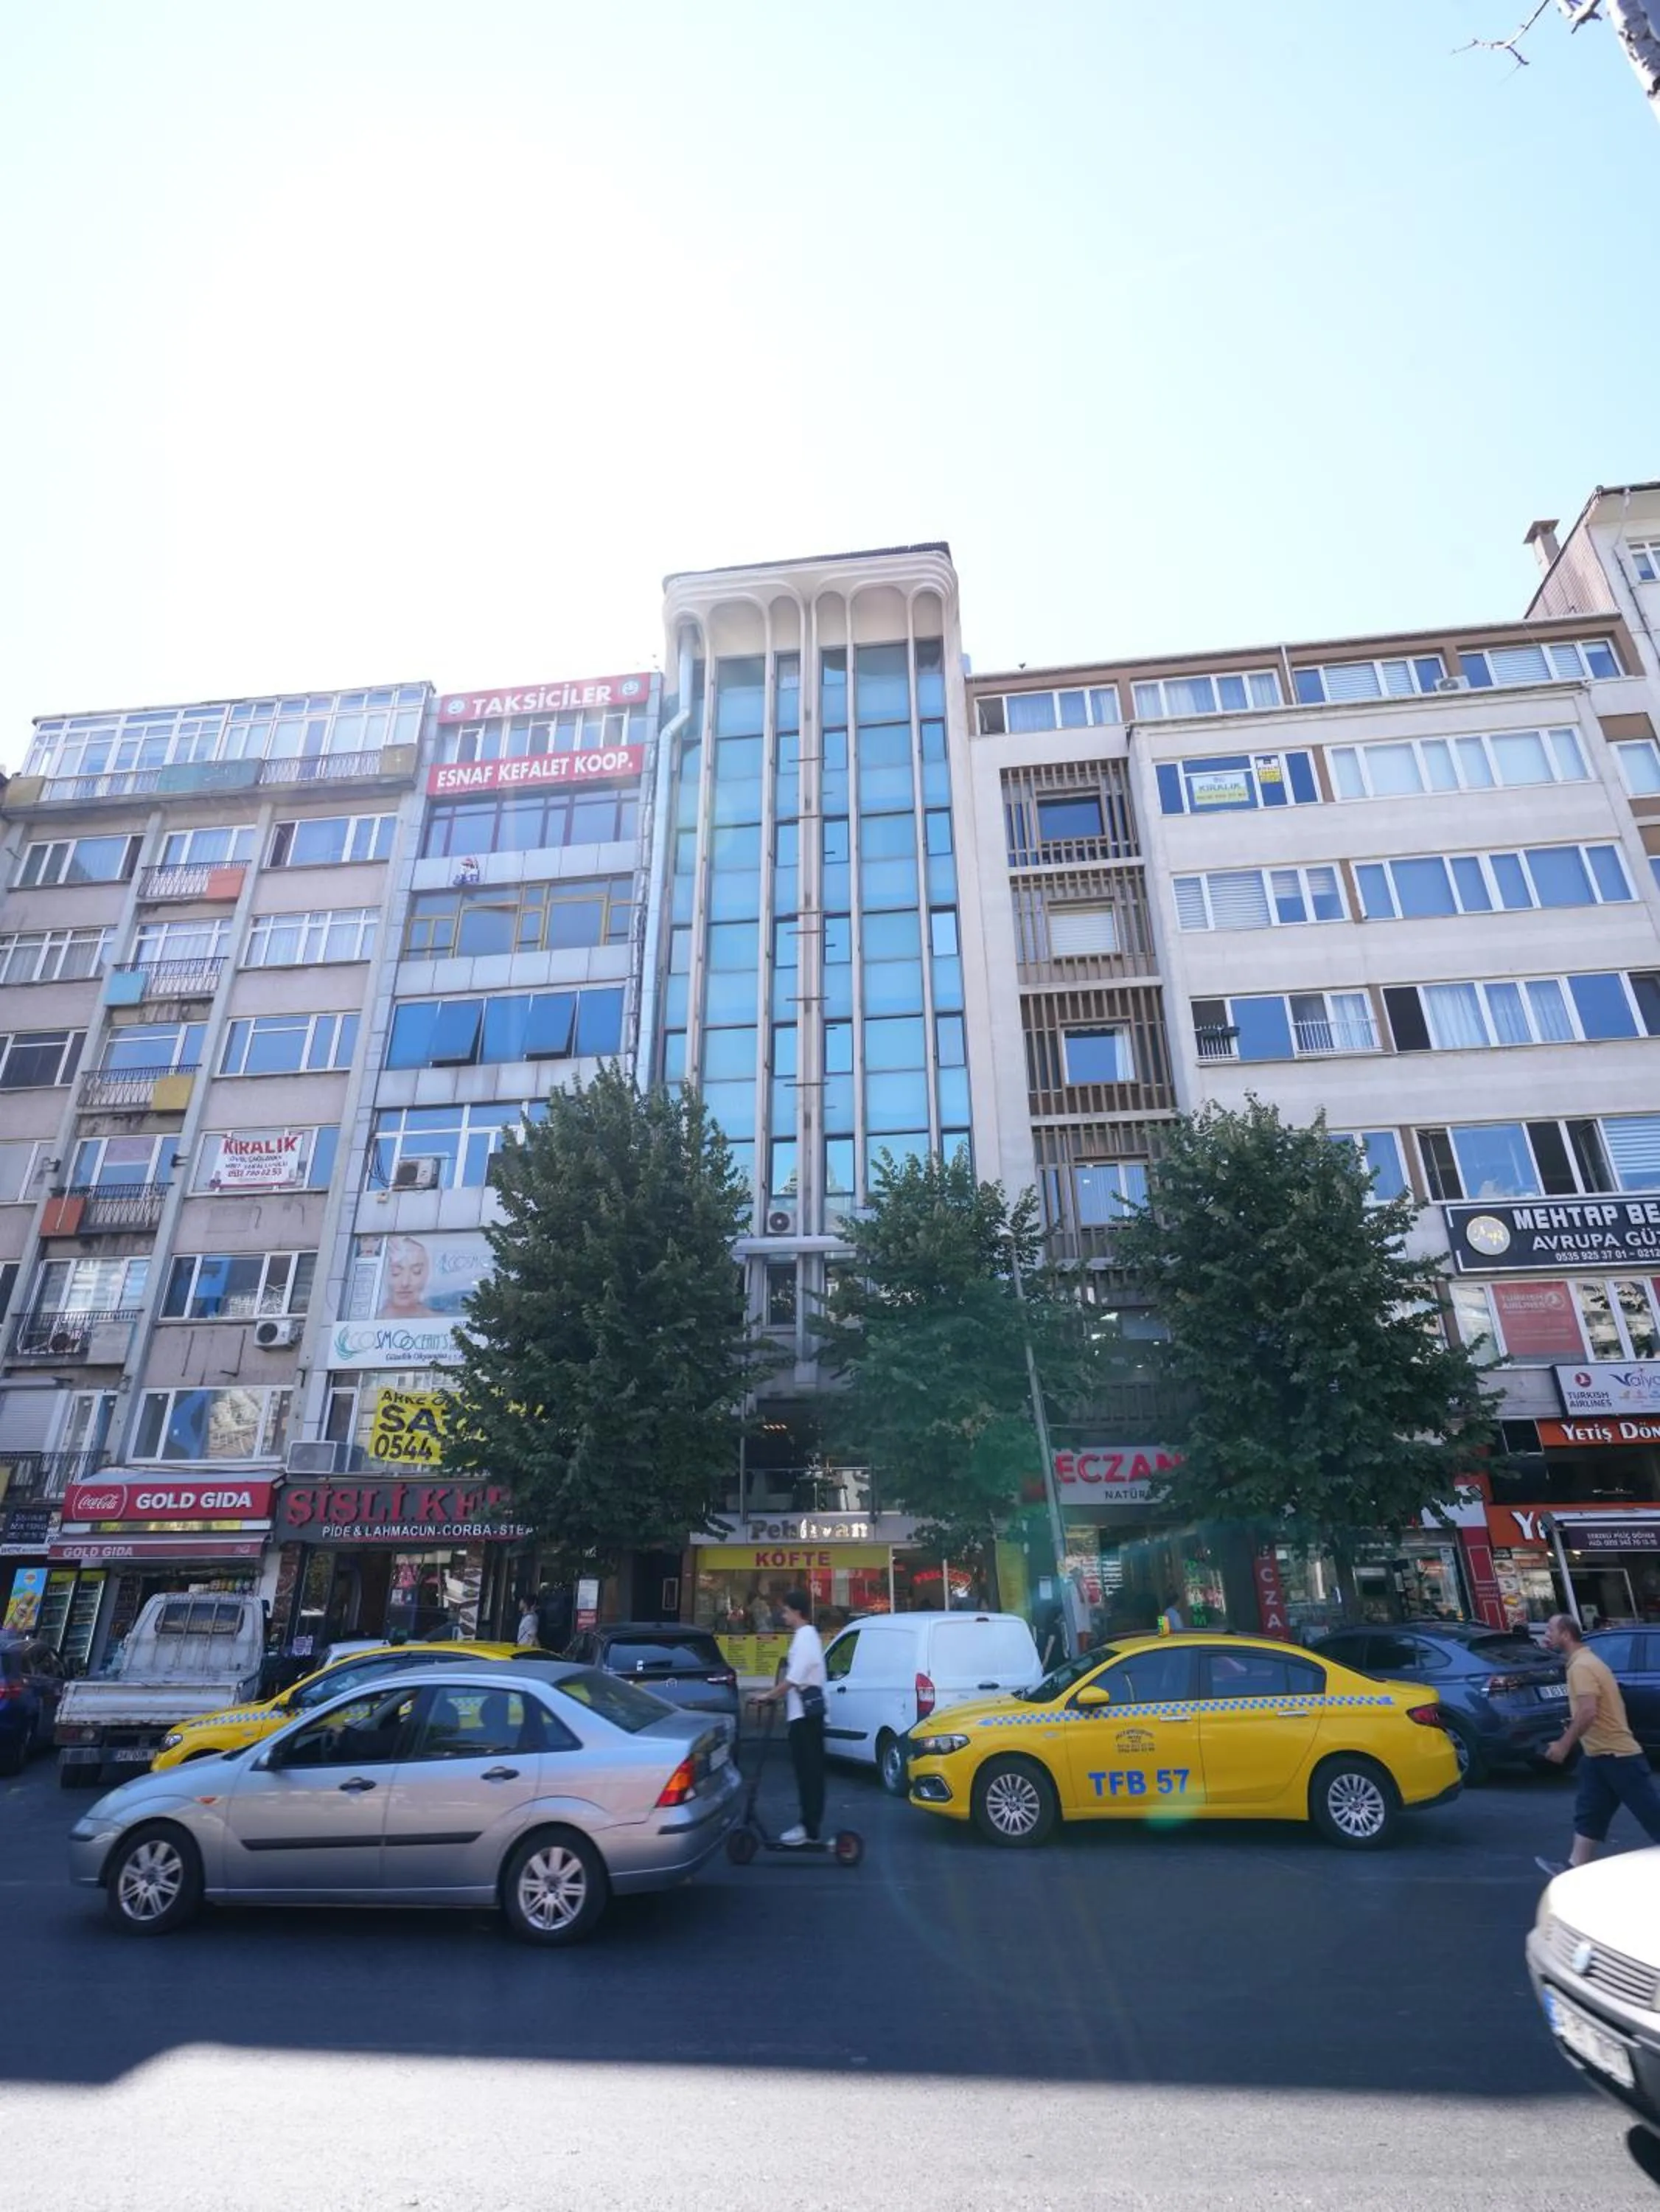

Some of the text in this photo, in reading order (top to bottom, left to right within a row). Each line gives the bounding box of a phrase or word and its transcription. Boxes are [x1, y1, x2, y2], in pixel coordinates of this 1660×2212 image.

[472, 684, 612, 715] TAKSİCİLER
[436, 751, 634, 787] ESNAF KEFALET KOOP.
[1513, 1205, 1619, 1230] MEHTAP
[1532, 1232, 1621, 1251] AVRUPA
[1555, 1251, 1580, 1262] 0535
[1600, 1250, 1612, 1259] 37
[1567, 1391, 1609, 1399] TURKISH
[1569, 1399, 1612, 1408] AIRLINES
[374, 1433, 433, 1461] 0544
[136, 1492, 252, 1509] GOLD GIDA
[322, 1524, 350, 1538] PİDE
[63, 1546, 133, 1557] GOLD GIDA
[756, 1549, 831, 1567] KÖFTE
[1088, 1769, 1189, 1796] TFB 57
